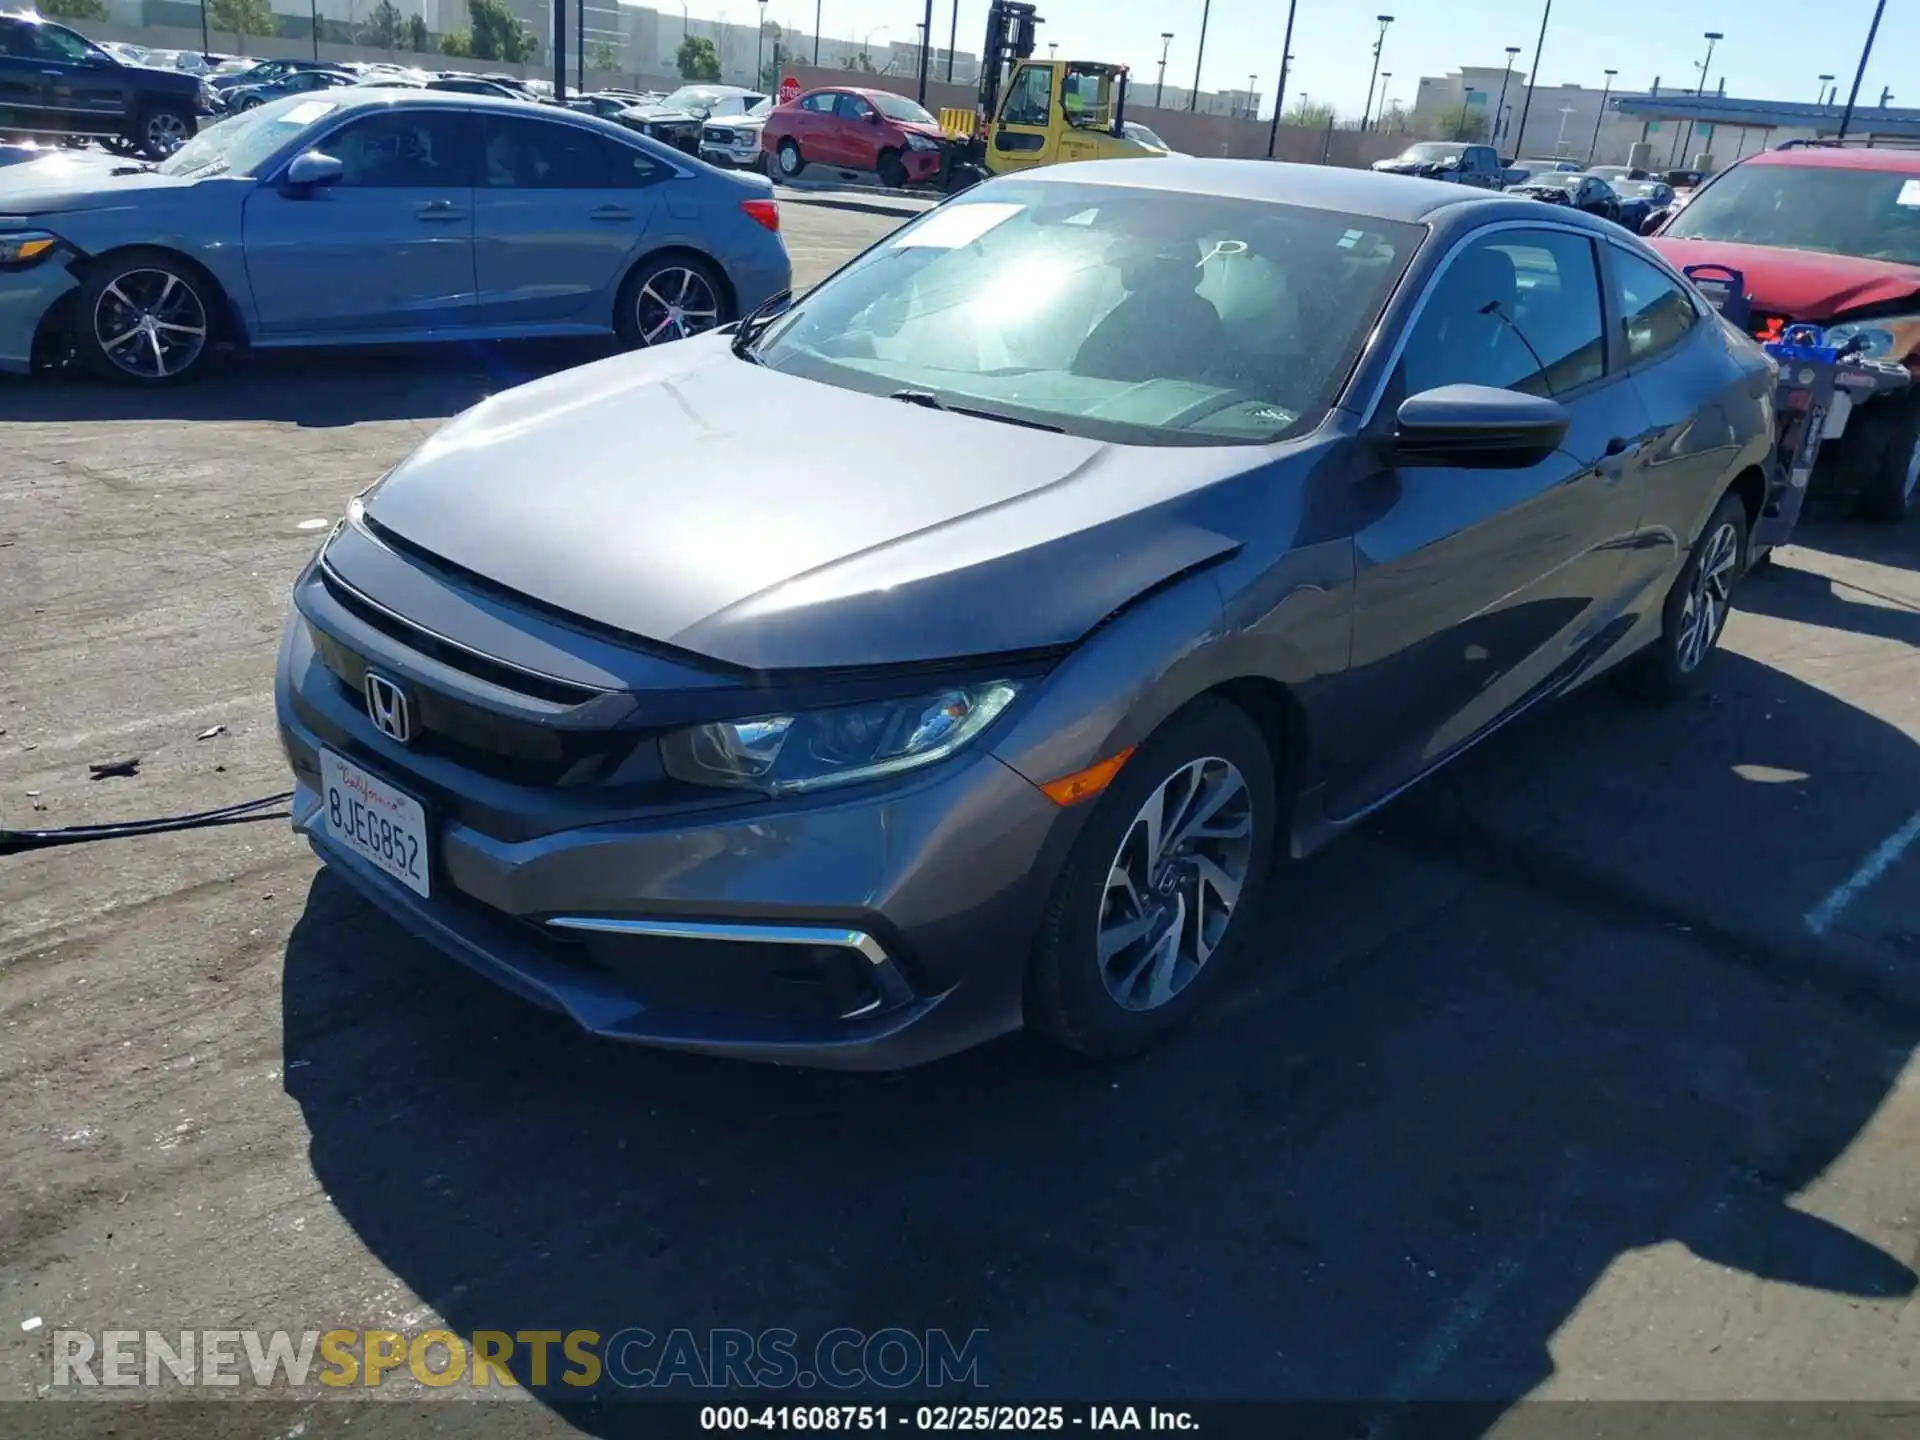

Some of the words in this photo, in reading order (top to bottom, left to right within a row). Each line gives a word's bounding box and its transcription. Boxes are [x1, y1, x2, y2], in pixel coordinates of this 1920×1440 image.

[781, 86, 800, 97] STOP
[341, 768, 398, 812] California
[329, 787, 421, 880] 8JEG852
